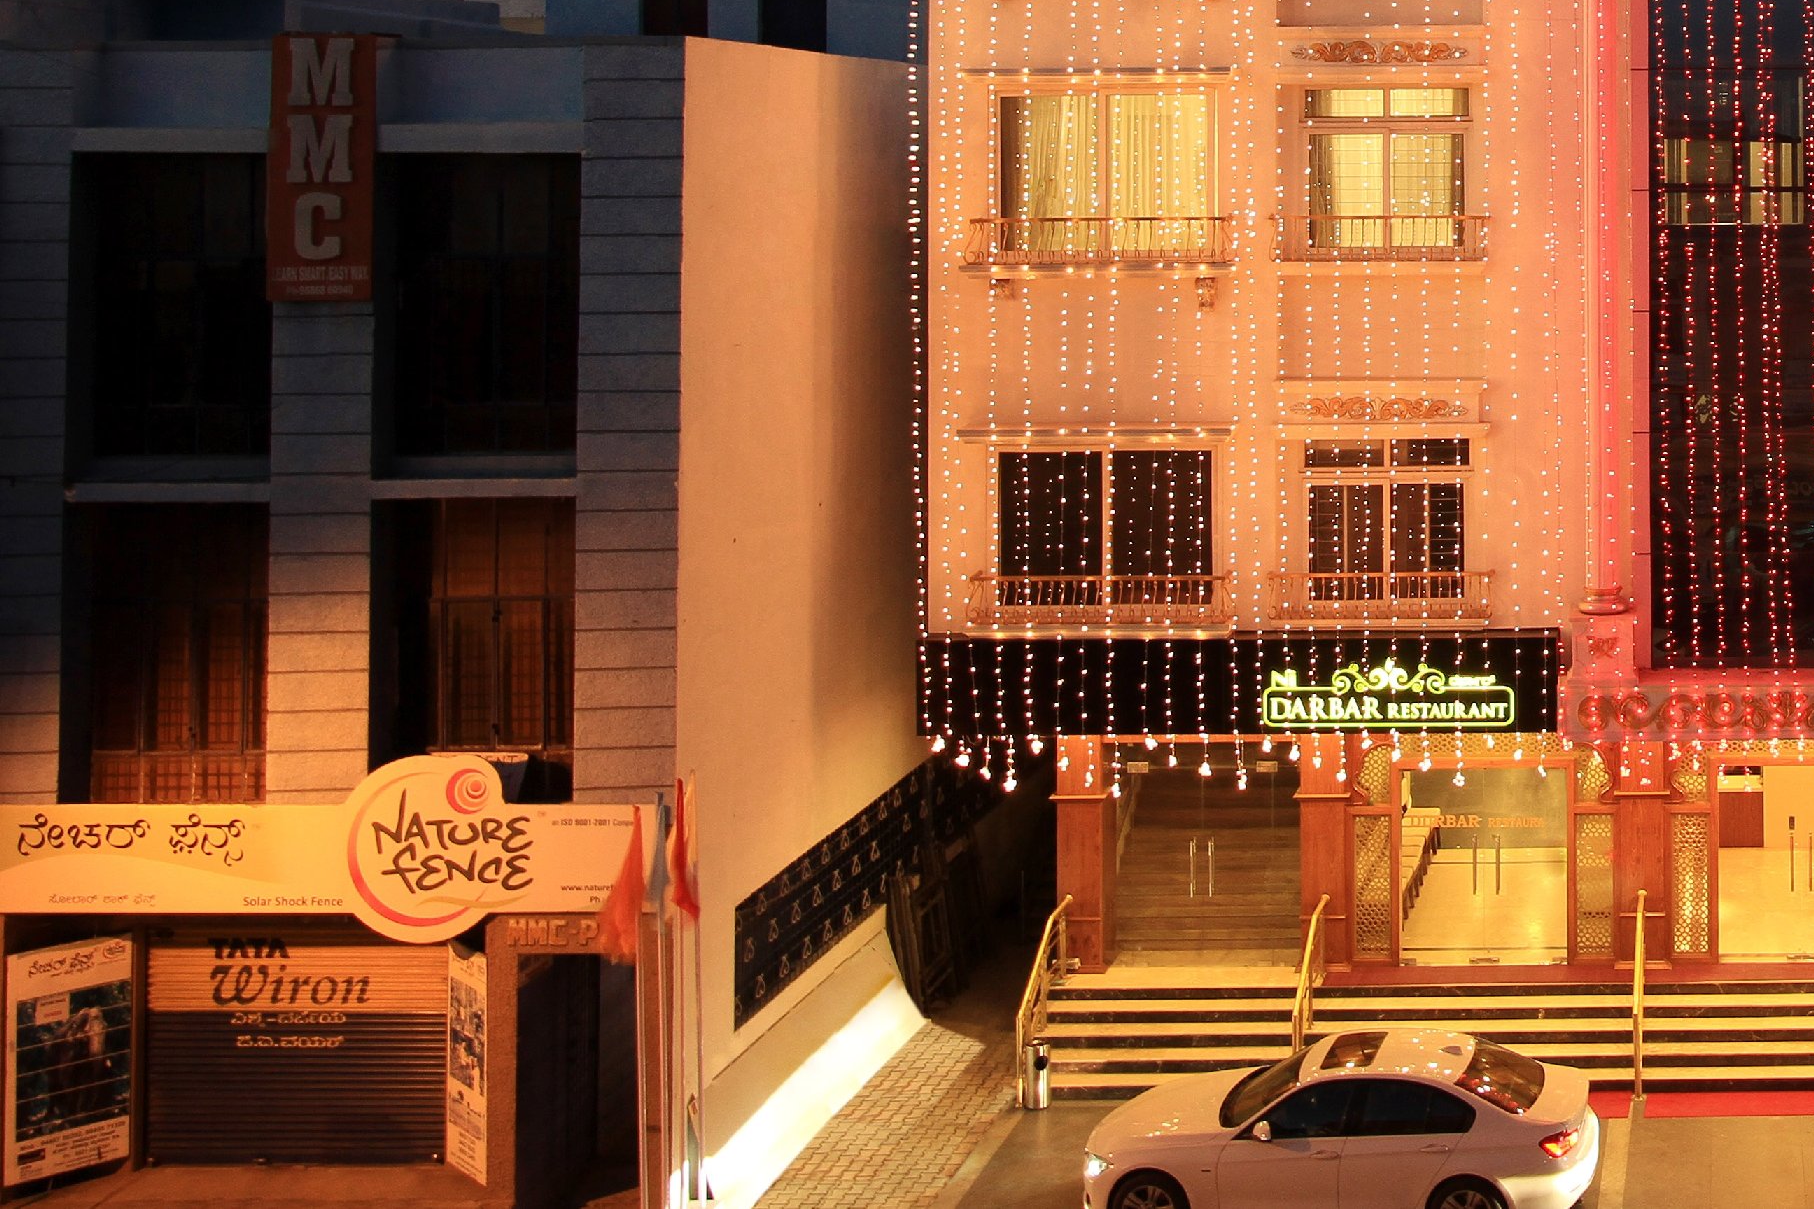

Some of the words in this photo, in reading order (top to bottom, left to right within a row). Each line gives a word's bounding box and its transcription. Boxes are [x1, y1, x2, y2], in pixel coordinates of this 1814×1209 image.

[286, 38, 355, 260] MMC
[1270, 697, 1383, 720] DARBAR
[1387, 702, 1507, 720] RESTAURANT
[18, 813, 151, 856] ನೇಚರ್
[371, 788, 534, 854] NATURE
[243, 896, 271, 907] Solar
[275, 895, 307, 907] Shock
[310, 896, 344, 908] Fence
[208, 938, 290, 959] TATA
[210, 964, 371, 1005] Wiron
